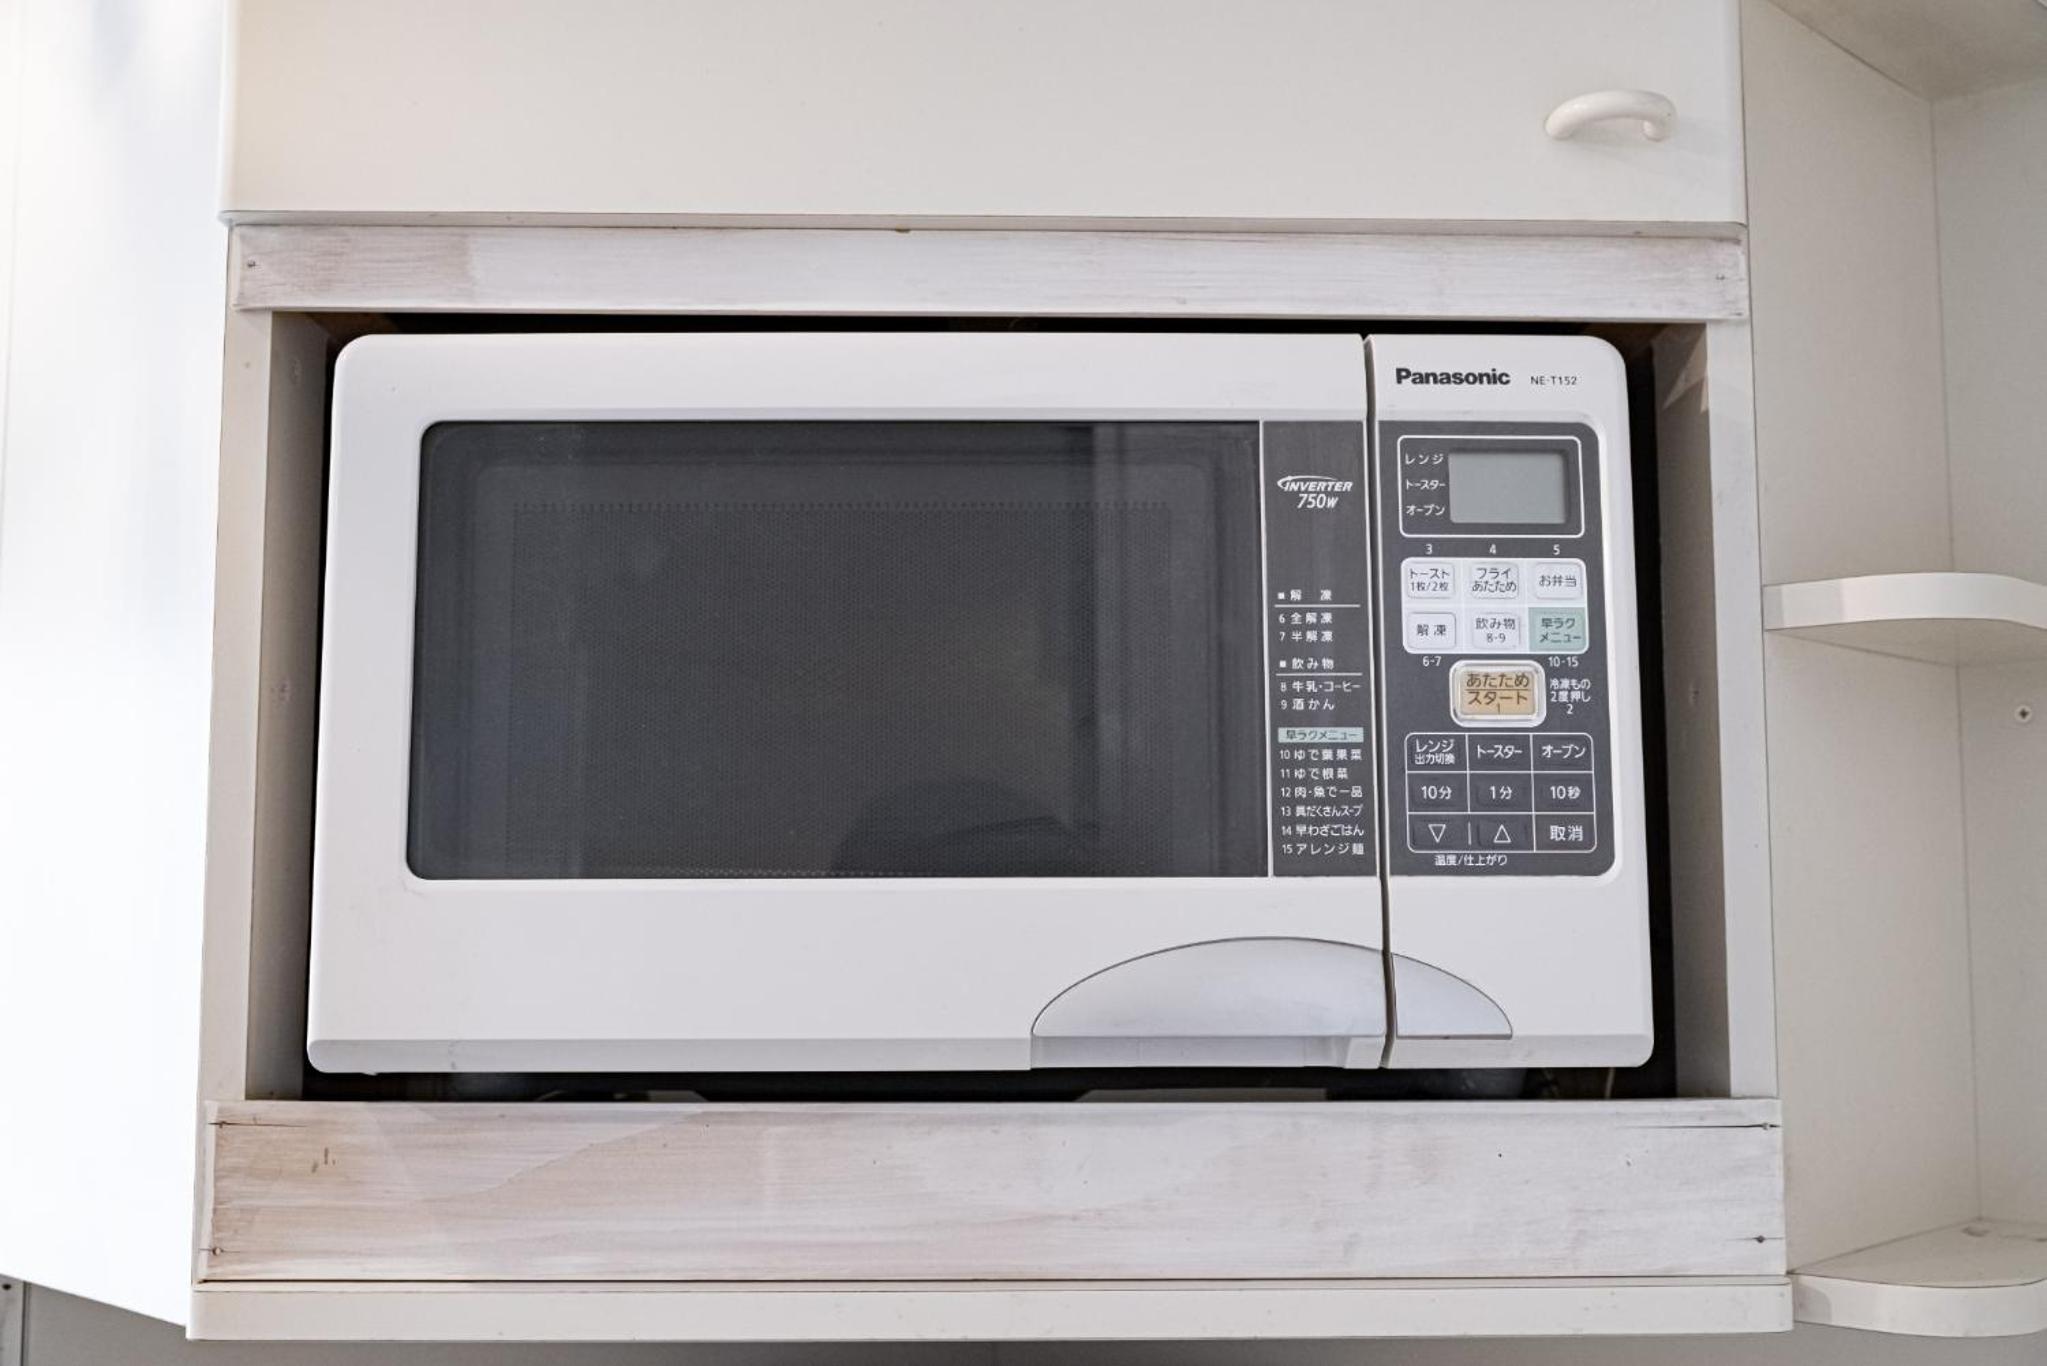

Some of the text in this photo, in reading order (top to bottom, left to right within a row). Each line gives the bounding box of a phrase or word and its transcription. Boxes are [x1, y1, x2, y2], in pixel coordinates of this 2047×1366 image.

[1395, 367, 1577, 386] Panasonic NE-T152
[1405, 453, 1444, 465] レンジ
[1280, 479, 1353, 492] INVERTER
[1406, 478, 1446, 490] トースター
[1405, 503, 1445, 516] オープン
[1426, 544, 1432, 554] 3
[1489, 544, 1497, 554] 4
[1553, 544, 1560, 555] 5
[1410, 568, 1450, 579] トースト
[1476, 567, 1511, 580] フライ
[1472, 580, 1517, 593] あたため
[1538, 575, 1577, 587] お弁当
[1279, 612, 1332, 624] 6 全解凍
[1476, 618, 1516, 630] 飲み物
[1541, 617, 1576, 629] 早ラク
[1280, 630, 1333, 642] 7 半解凍
[1540, 632, 1581, 643] メニュー
[1292, 658, 1334, 670] 飲み物
[1466, 672, 1530, 688] あたため
[1549, 678, 1591, 690] 冷凍もの
[1281, 682, 1287, 692] 8
[1468, 690, 1528, 705] スタート
[1550, 691, 1591, 702] 2度押し
[1281, 698, 1335, 711] 9 酒かん
[1566, 703, 1573, 714] 2
[1286, 729, 1360, 740] 早ラクメニュー
[1415, 738, 1455, 753] レンジ
[1476, 744, 1523, 759] トースター
[1541, 744, 1586, 759] オープン
[1280, 749, 1290, 760] 10
[1414, 753, 1455, 765] 出力切換
[1280, 769, 1290, 778] 11
[1281, 787, 1291, 797] 12
[1421, 786, 1452, 799] 10分
[1489, 786, 1512, 799] 1分
[1550, 786, 1581, 799] 10秒
[1281, 806, 1291, 816] 13
[1281, 824, 1364, 837] 14 早わざごはん
[1550, 825, 1583, 841] 取消
[1282, 844, 1293, 854] 15
[1435, 854, 1508, 866] 温度/仕上がり
